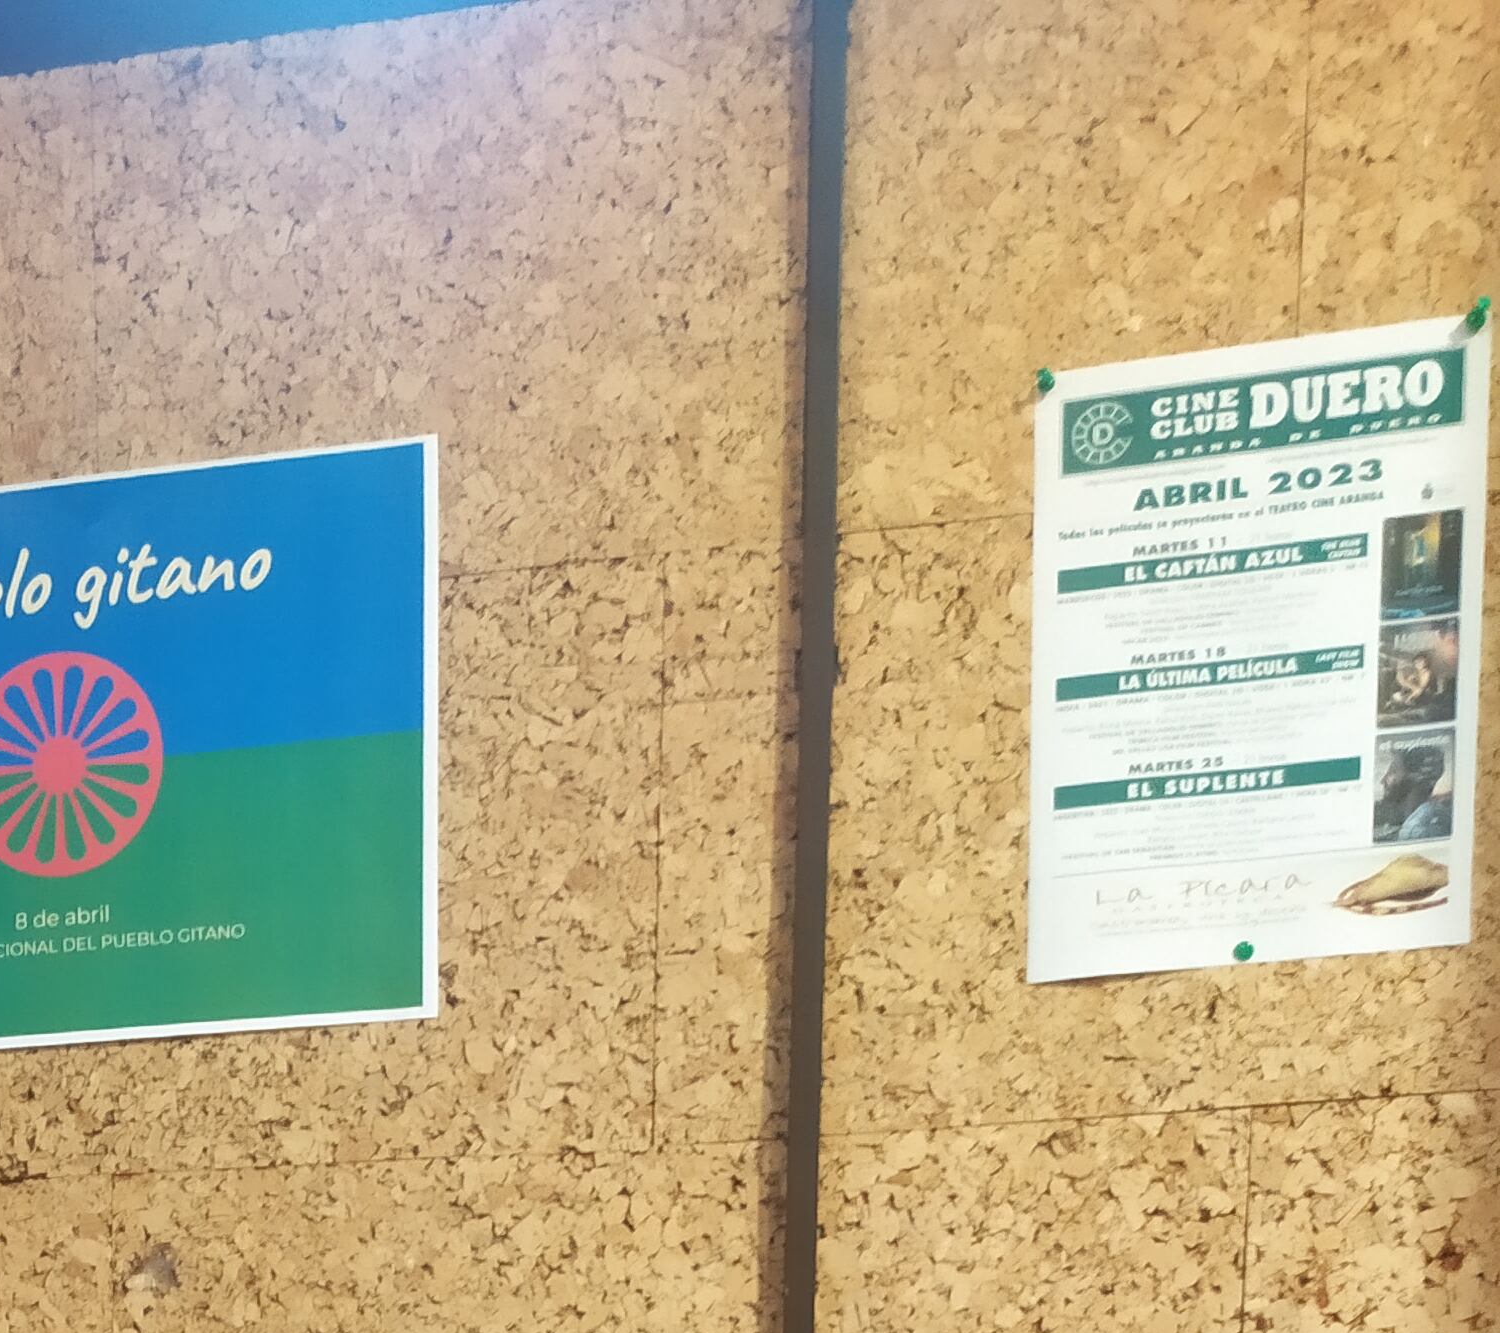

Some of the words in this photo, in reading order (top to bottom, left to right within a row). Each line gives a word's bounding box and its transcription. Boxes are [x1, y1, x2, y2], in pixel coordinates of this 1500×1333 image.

[1150, 387, 1240, 417] CINE
[1249, 359, 1444, 430] DUERO
[1150, 411, 1240, 440] CLUB
[1154, 437, 1262, 460] ARANDA
[1289, 429, 1322, 443] DE
[1349, 413, 1443, 435] DUERO
[1133, 476, 1248, 512] ABRIL
[1268, 459, 1384, 495] 2023
[1268, 501, 1306, 516] TEATRO
[1311, 496, 1335, 509] CINE
[1132, 539, 1199, 557] MARTES
[1124, 566, 1148, 583] EL
[1154, 555, 1238, 580] CAFTÁN
[1244, 548, 1303, 569] AZUL
[74, 544, 273, 630] gitano
[1131, 650, 1196, 666] MARTES
[1205, 646, 1227, 659] 18
[1118, 673, 1142, 691] LA
[1146, 666, 1212, 688] ÚLTIMA
[1216, 657, 1299, 682] PELÍCULA
[1128, 759, 1194, 776] MARTES
[1201, 756, 1224, 768] 25
[1125, 782, 1154, 799] EL
[1164, 769, 1285, 796] SUPLENTE
[15, 912, 28, 931] 8
[33, 909, 60, 929] de
[64, 904, 110, 926] abril
[62, 935, 97, 954] DEL
[101, 928, 174, 951] PUEBLO
[177, 922, 246, 946] GITANO
